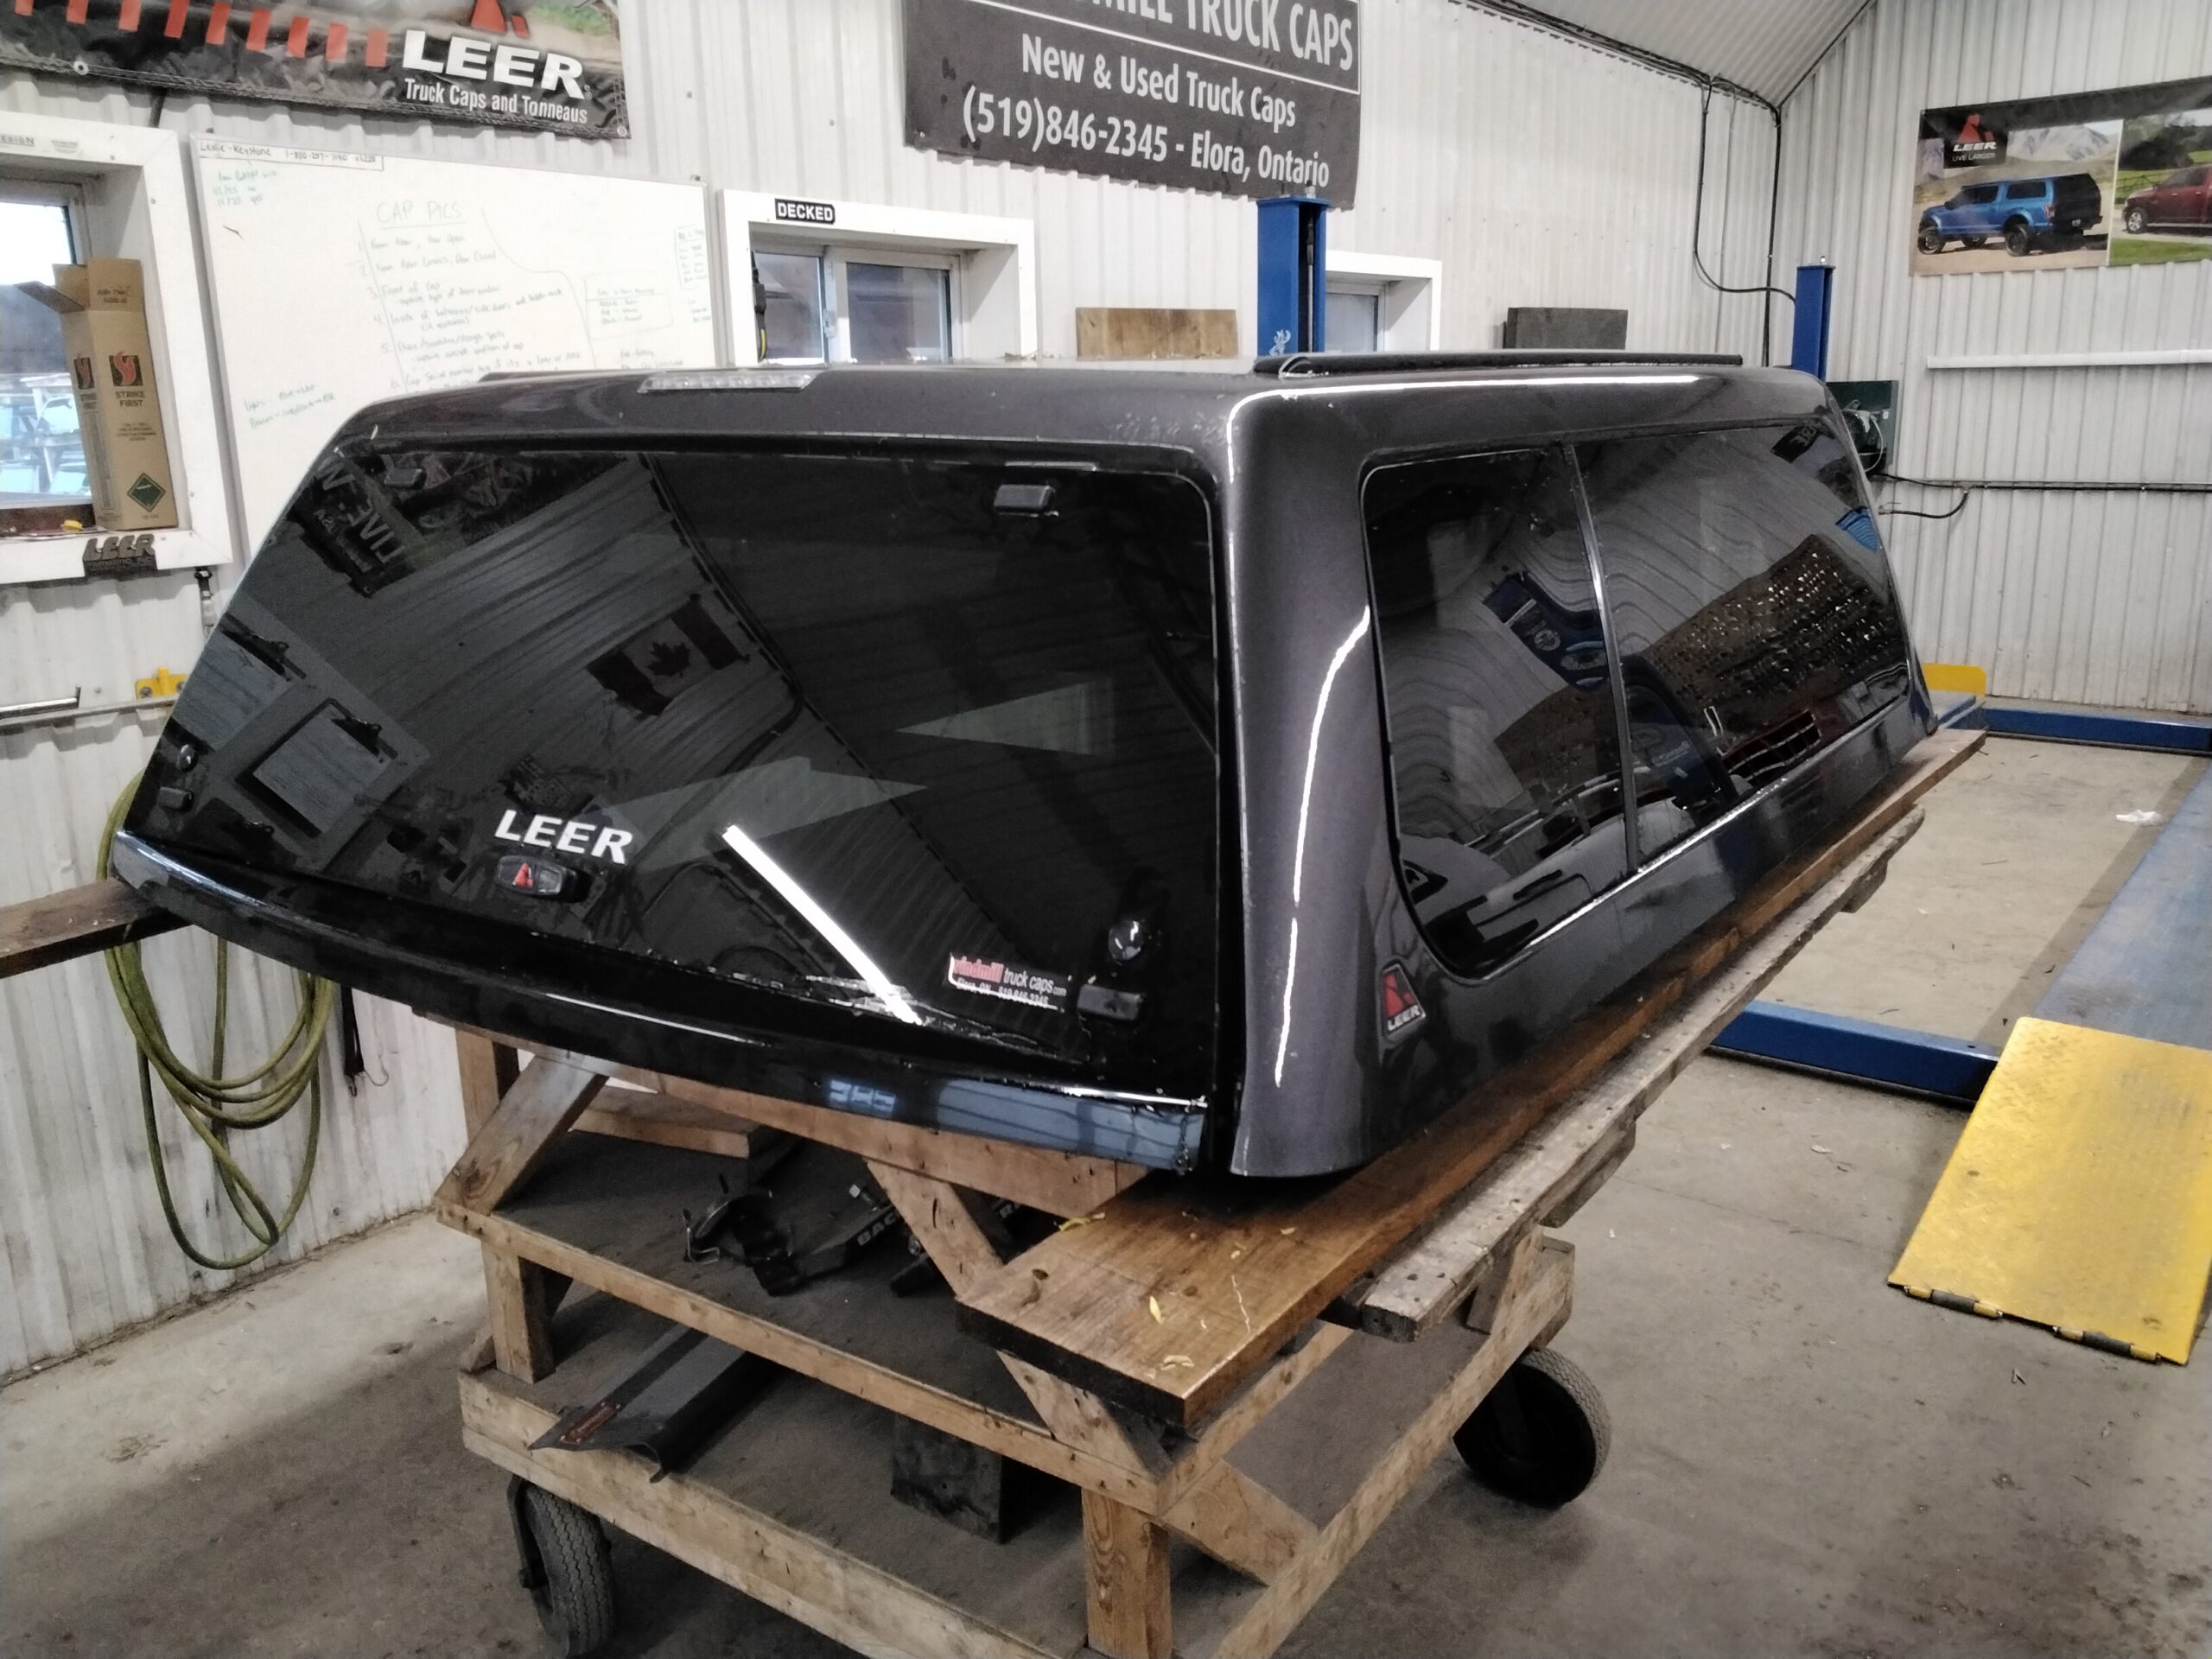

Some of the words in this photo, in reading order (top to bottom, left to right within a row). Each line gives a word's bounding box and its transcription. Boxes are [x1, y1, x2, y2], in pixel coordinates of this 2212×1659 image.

[1289, 3, 1353, 71] CAPS
[403, 29, 586, 99] LEER
[1022, 33, 1084, 83] New
[1093, 54, 1111, 90] &
[1120, 55, 1179, 103] Used
[1186, 70, 1243, 117] Truck
[1251, 86, 1295, 133] Caps
[404, 78, 444, 104] Truck
[449, 84, 486, 111] Caps
[492, 93, 517, 113] and
[522, 95, 588, 124] Tonneaus
[963, 85, 1167, 162] (519)846-2345
[1192, 130, 1250, 182] Elora,
[1258, 145, 1329, 188] Ontario
[1953, 142, 1997, 151] LEER
[377, 200, 413, 223] CAP
[427, 200, 462, 220] PICS
[778, 202, 833, 221] DECKED
[115, 391, 145, 399] STRIKE
[119, 399, 143, 408] FIRST
[82, 534, 155, 562] LEER
[494, 809, 632, 864] LEER
[1003, 967, 1028, 988] truck
[1388, 1005, 1421, 1031] LEER
